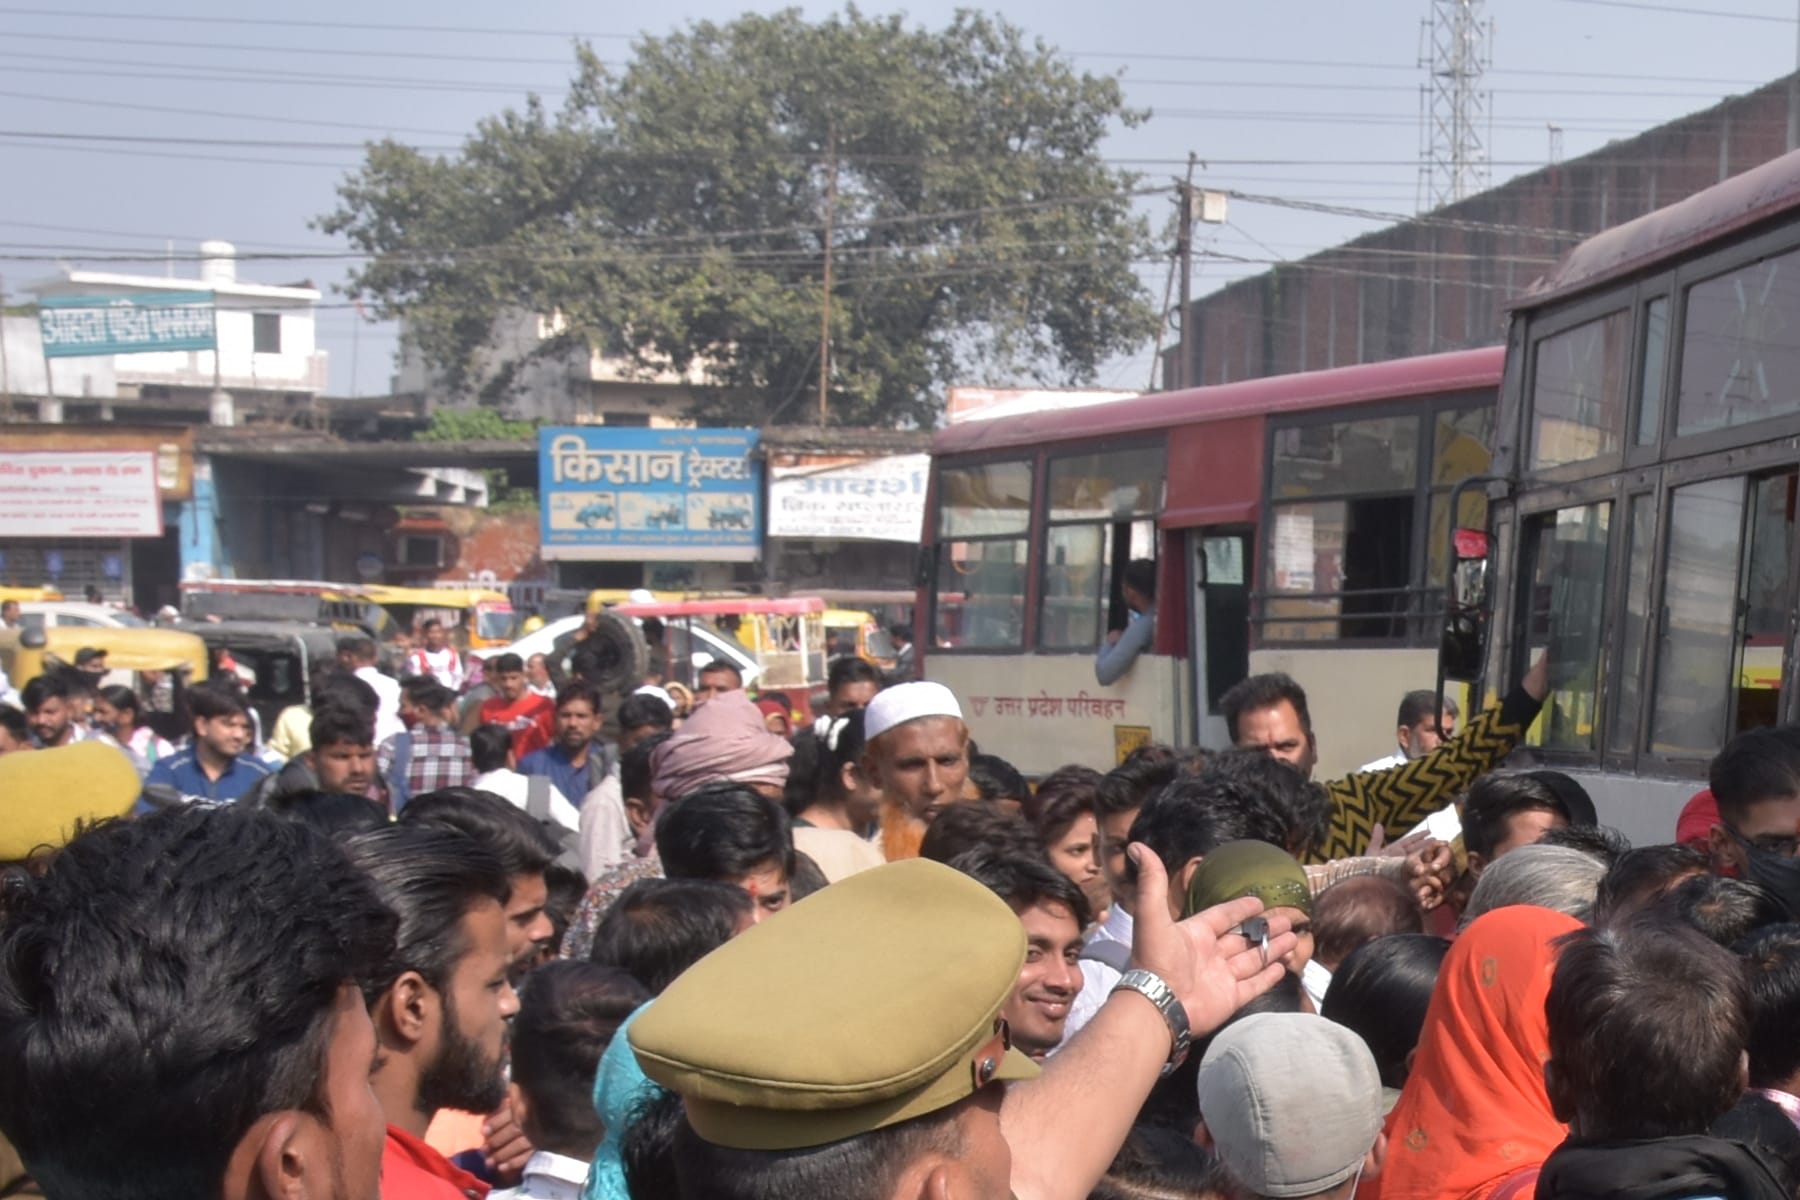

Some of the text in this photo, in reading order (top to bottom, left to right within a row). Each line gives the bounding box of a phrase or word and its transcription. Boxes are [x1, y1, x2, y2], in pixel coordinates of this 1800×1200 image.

[550, 434, 684, 484] किसान
[994, 690, 1126, 720] उत्तर प्रदेश परिवहन
